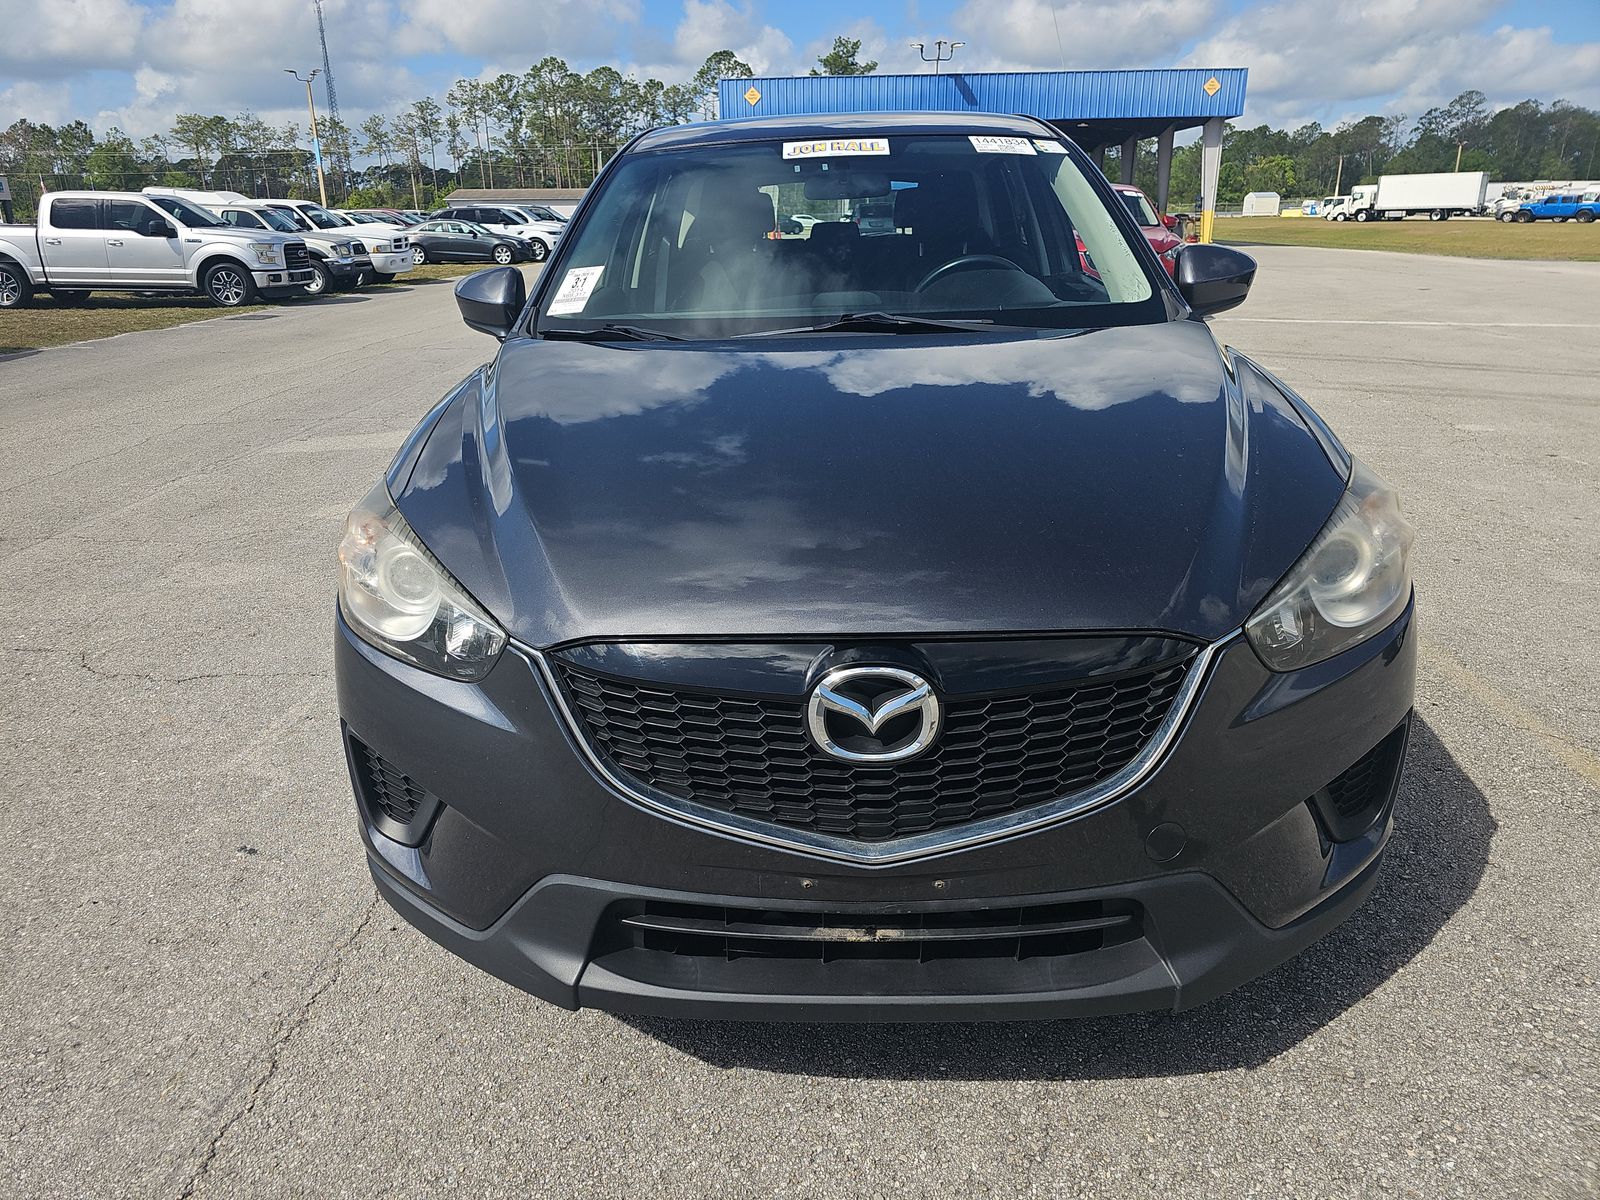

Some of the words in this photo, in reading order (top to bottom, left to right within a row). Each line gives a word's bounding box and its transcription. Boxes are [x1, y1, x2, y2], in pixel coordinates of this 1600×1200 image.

[787, 142, 827, 157] JON
[831, 140, 886, 152] HALL
[974, 136, 1028, 147] 1441834
